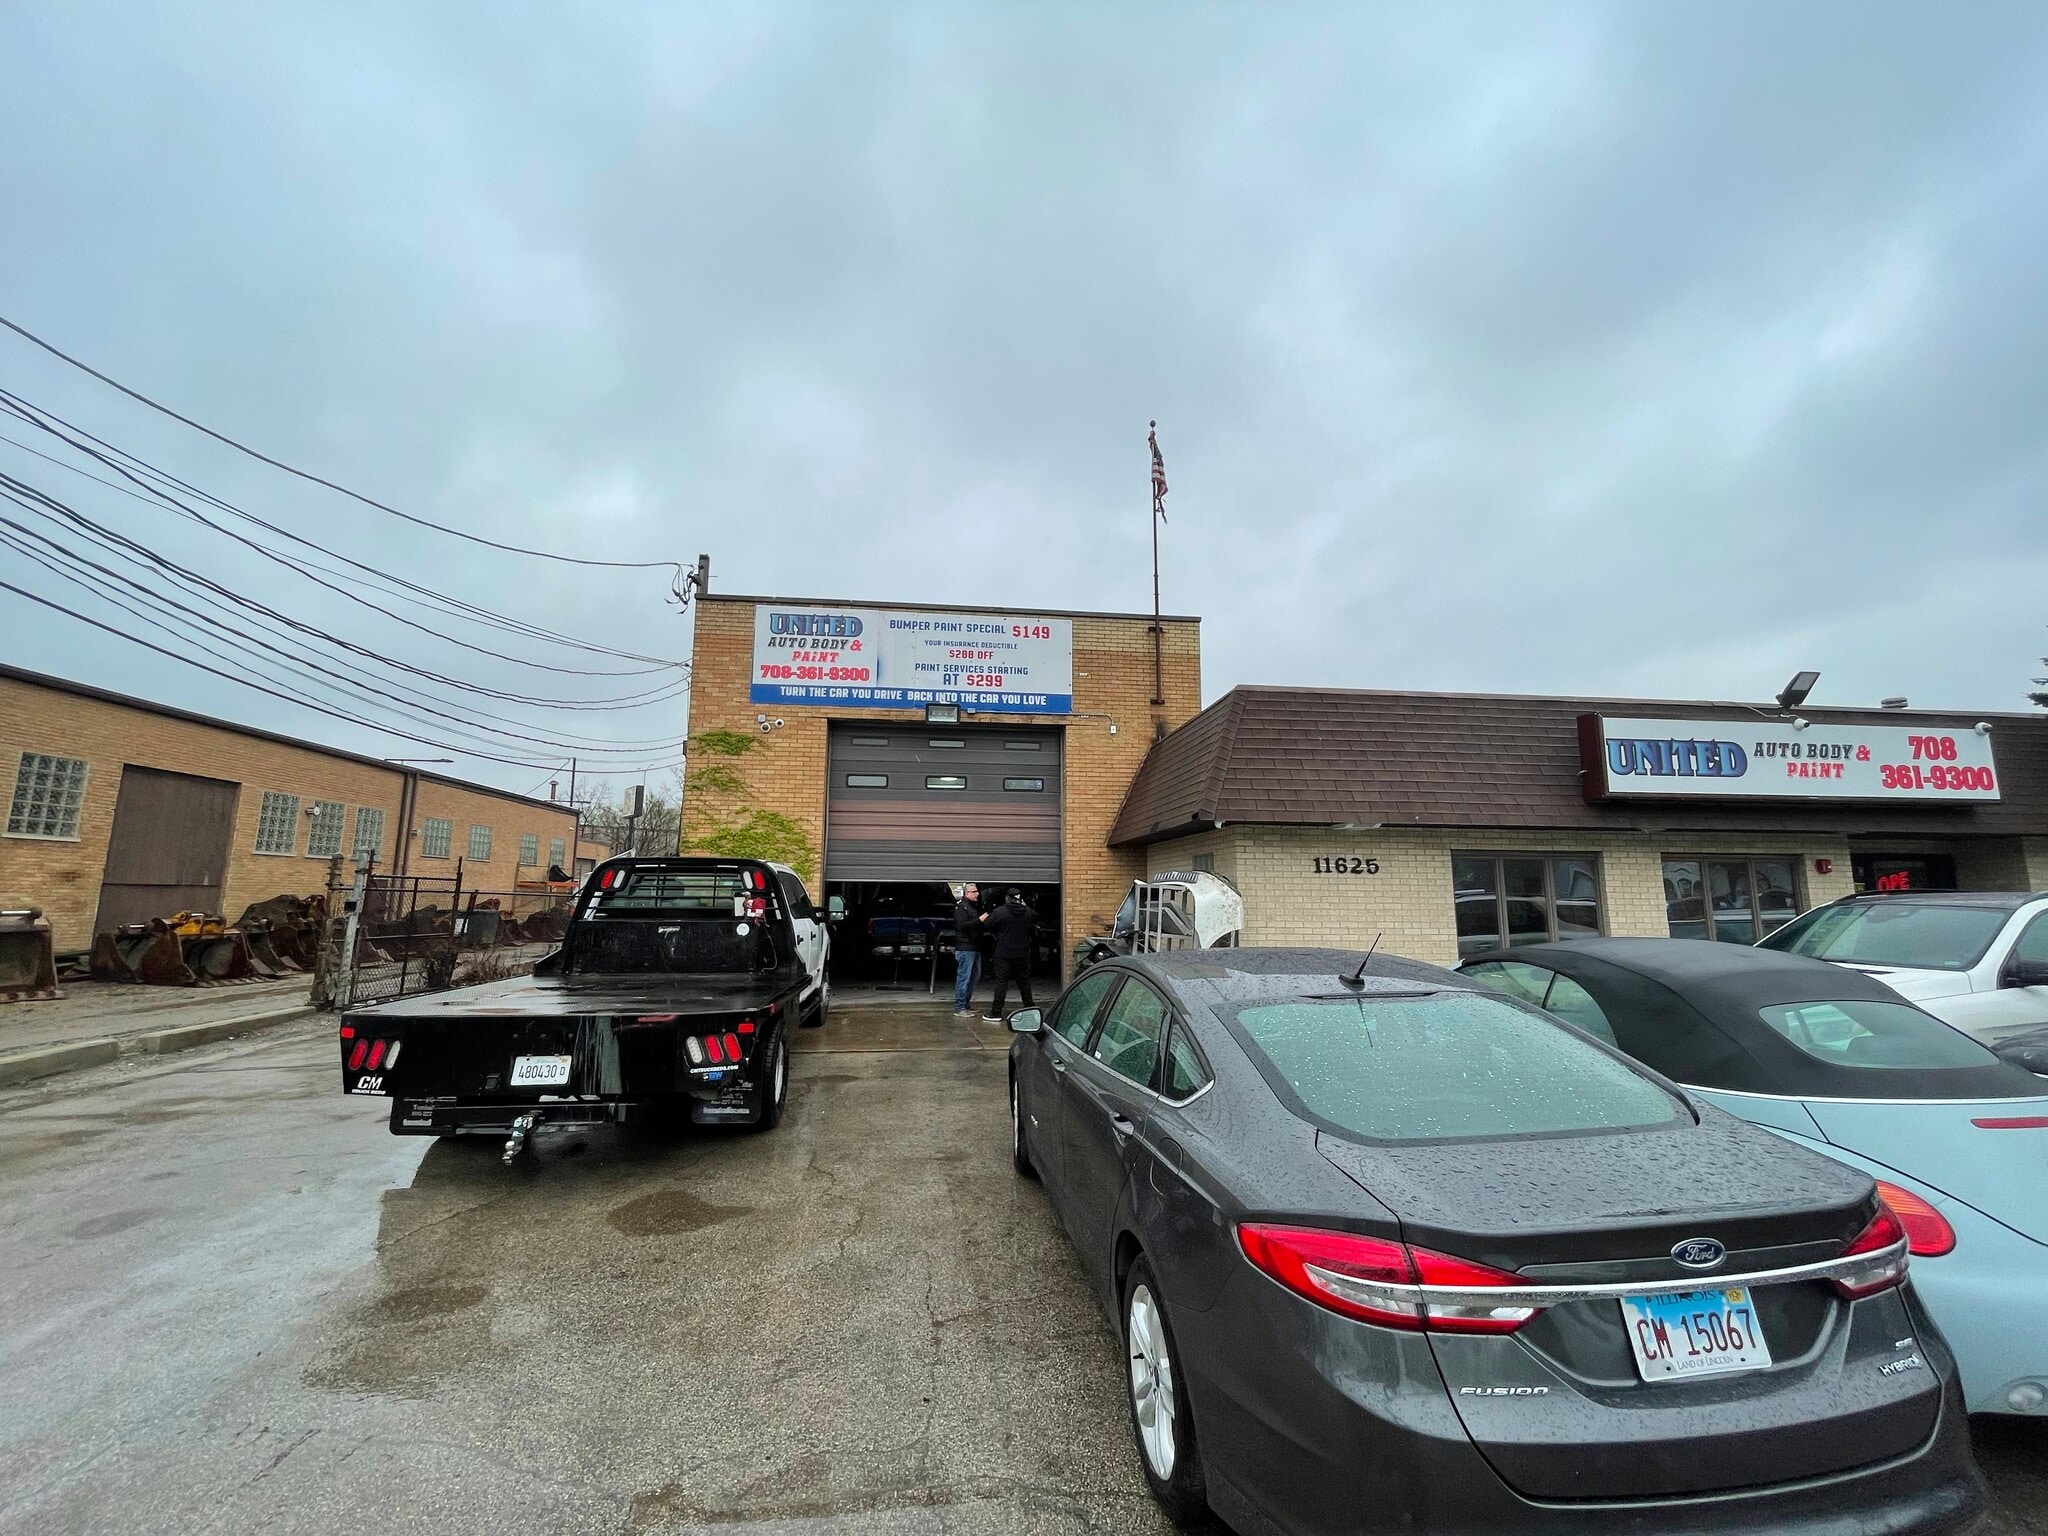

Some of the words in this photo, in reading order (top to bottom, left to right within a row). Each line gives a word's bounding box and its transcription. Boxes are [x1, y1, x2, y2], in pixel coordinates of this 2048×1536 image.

[770, 613, 864, 637] UNITED
[889, 620, 930, 631] BUMPER
[934, 622, 962, 632] PAINT
[966, 623, 1006, 634] SPECIAL
[1012, 625, 1050, 639] $149
[768, 637, 807, 648] AUTO
[810, 638, 848, 649] BODY
[850, 639, 863, 651] &
[981, 641, 1018, 649] DEDUCTIBLE
[977, 651, 994, 660] OFF
[760, 665, 870, 681] 708-361-9300
[915, 663, 940, 672] PAINT
[943, 664, 984, 674] SERVICES
[987, 666, 1029, 675] STARTING
[943, 673, 959, 686] AT
[966, 674, 1003, 687] $299
[780, 686, 806, 697] TURN
[809, 687, 827, 697] THE
[829, 688, 849, 698] CAR
[852, 689, 871, 699] YOU
[874, 689, 902, 700] DRIVE
[907, 691, 933, 701] BACK
[936, 692, 957, 702] INTO
[960, 693, 978, 703] THE
[980, 693, 999, 704] CAR
[1002, 694, 1020, 704] YOU
[1023, 695, 1047, 705] LOVE
[1753, 742, 1802, 758] AUTO
[1806, 743, 1854, 760] BODY
[1855, 744, 1871, 762] &
[1908, 736, 1957, 761] 708
[1605, 737, 1748, 778] UNITED
[1880, 764, 1994, 791] 361-9300
[1313, 857, 1380, 874] 11625
[518, 1065, 558, 1079] 480430
[357, 1075, 383, 1090] CM
[1685, 1244, 1716, 1261] Ford
[1637, 1317, 1673, 1360] CM
[1680, 1308, 1756, 1356] 15067
[1459, 1386, 1549, 1397] FUSION
